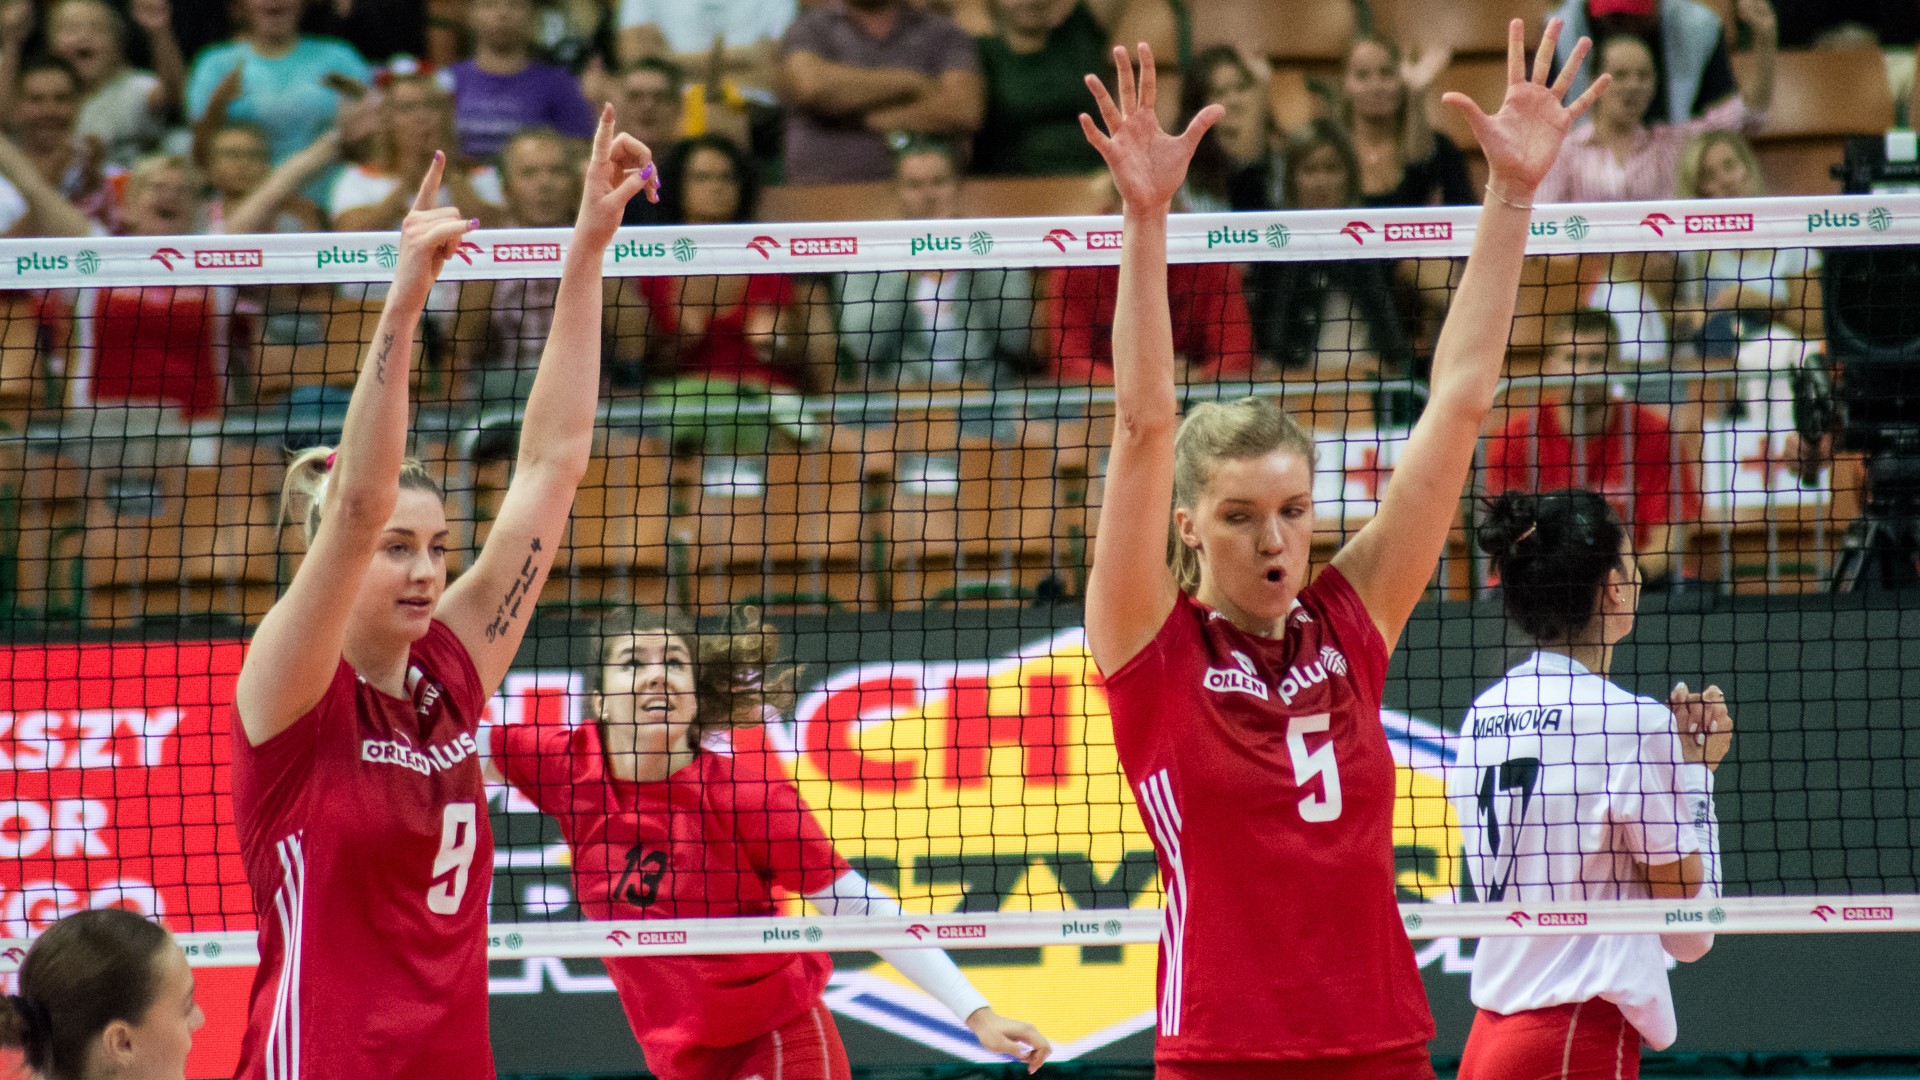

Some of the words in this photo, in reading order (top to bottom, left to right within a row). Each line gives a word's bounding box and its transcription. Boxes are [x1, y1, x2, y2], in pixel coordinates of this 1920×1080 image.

[16, 252, 69, 275] plus
[197, 251, 261, 267] ORLEN
[317, 245, 369, 269] plus
[495, 245, 559, 261] ORLEN
[614, 239, 666, 262] plus
[792, 238, 856, 255] ORLEN
[911, 232, 962, 256] plus
[1089, 232, 1124, 248] ORL
[1207, 226, 1259, 249] plus
[1387, 224, 1450, 240] ORLEN
[1529, 221, 1558, 235] us
[1687, 215, 1752, 231] ORLEN
[1807, 209, 1861, 232] plus
[1206, 670, 1266, 699] ORLEN
[1277, 661, 1329, 706] plu
[363, 740, 430, 776] ORLEN
[430, 732, 477, 772] lus
[1286, 712, 1343, 823] 5
[1478, 757, 1540, 902] 17
[427, 802, 477, 915] 9
[613, 844, 668, 907] 13
[638, 931, 687, 945] ORLEN
[763, 927, 801, 944] plus
[938, 925, 985, 938] ORLEN
[1062, 920, 1100, 937] plus
[1539, 913, 1586, 926] ORLEN
[1665, 909, 1704, 925] plus
[1845, 908, 1892, 920] ORLEN
